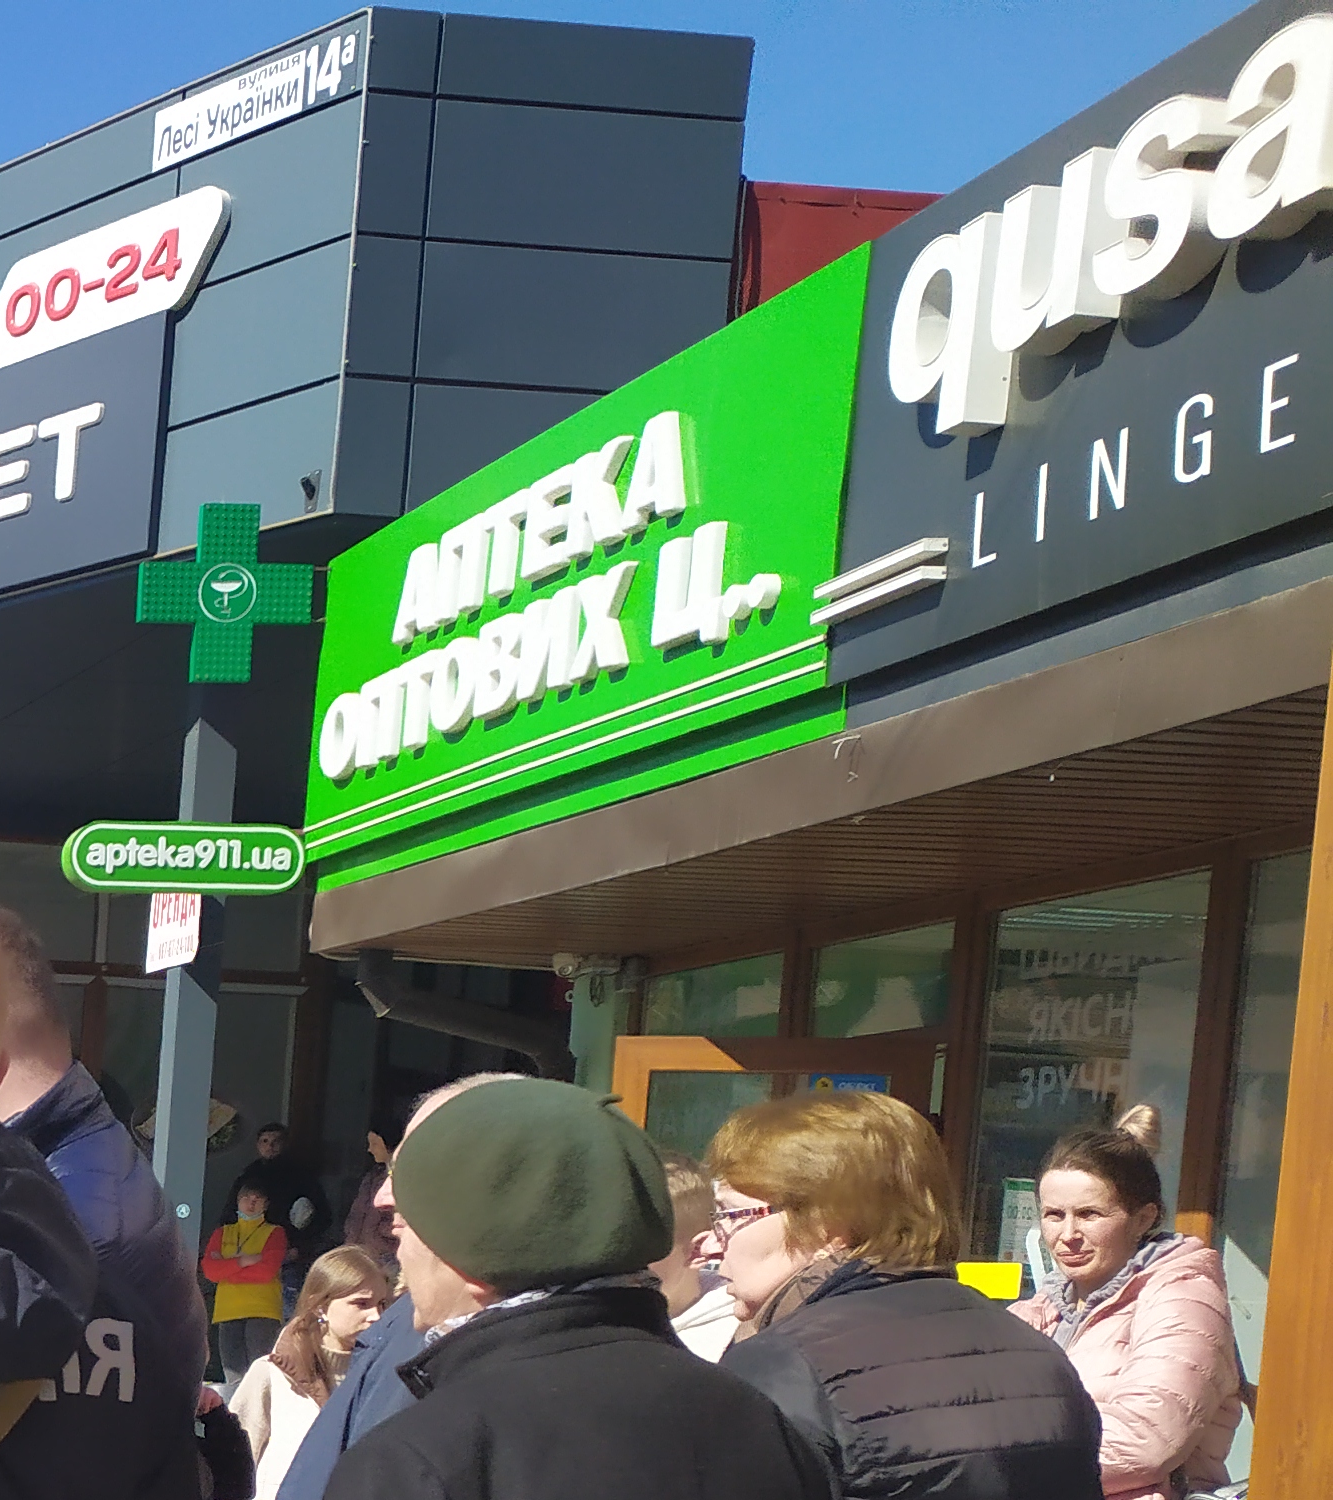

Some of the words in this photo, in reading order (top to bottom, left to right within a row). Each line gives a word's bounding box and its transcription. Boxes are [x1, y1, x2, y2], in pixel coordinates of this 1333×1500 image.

[157, 114, 200, 161] Лесі
[206, 77, 299, 139] Українки
[238, 54, 301, 90] вулиця
[6, 228, 182, 337] 00-24
[972, 353, 1299, 568] LINGE
[391, 410, 687, 645] АПТЕКА
[319, 561, 639, 780] ОПТОВИХ
[86, 836, 292, 875] apteka911.ua
